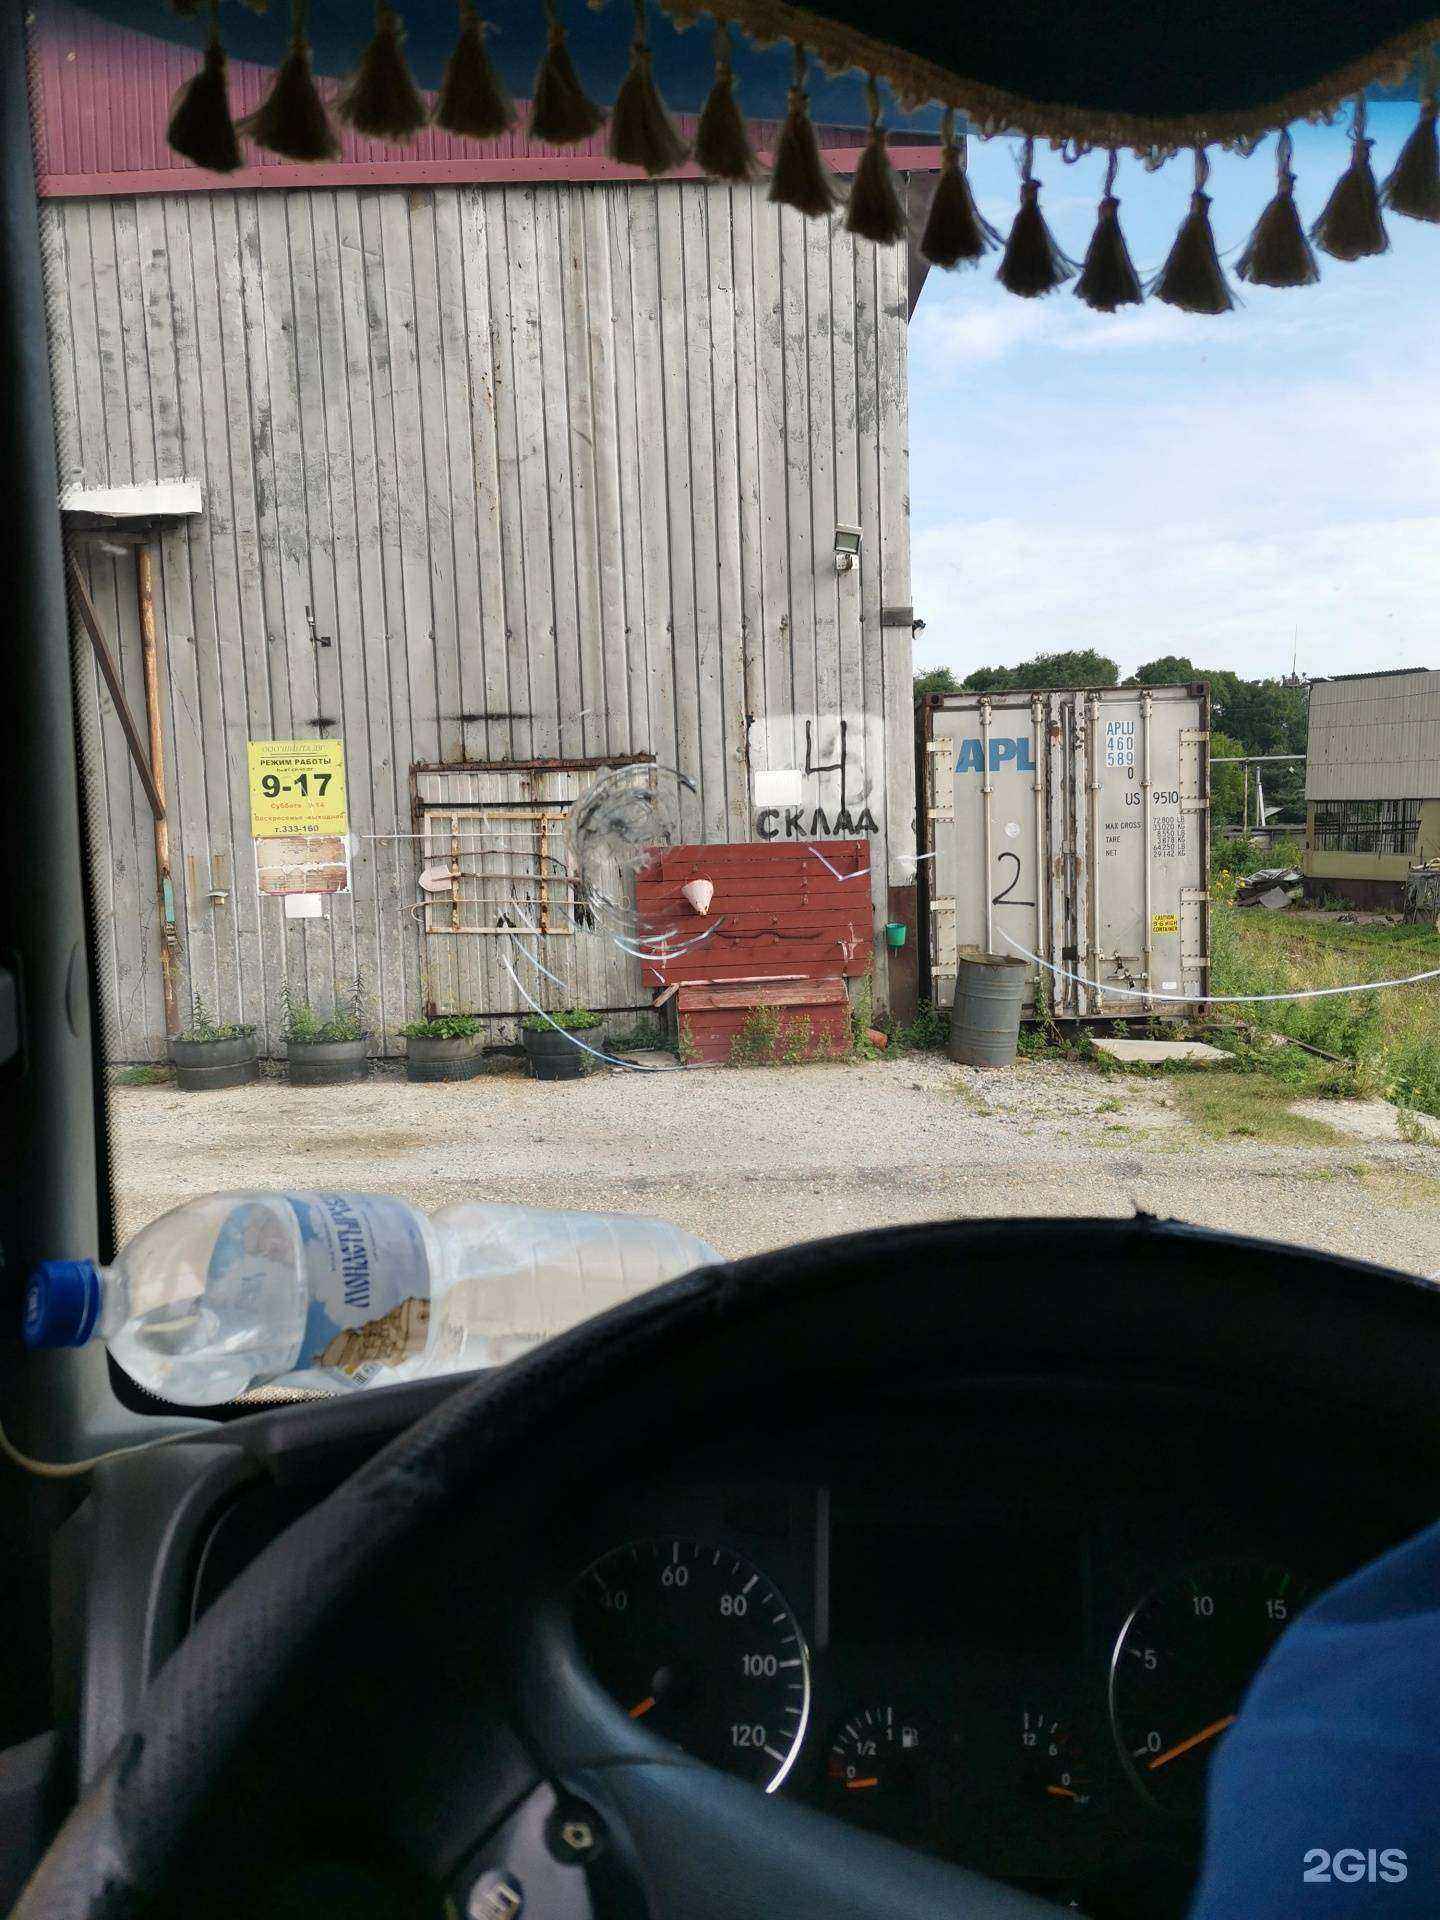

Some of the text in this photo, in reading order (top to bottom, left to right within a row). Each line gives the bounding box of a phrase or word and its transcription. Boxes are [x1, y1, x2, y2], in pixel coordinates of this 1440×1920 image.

[1106, 721, 1134, 736] APLU
[1107, 736, 1134, 751] 460
[260, 758, 331, 767] РЕЖИМ РАБОТЫ
[955, 737, 1036, 773] APL
[1107, 752, 1134, 767] 589
[805, 720, 848, 813] 4
[1127, 766, 1134, 780] 0
[261, 773, 333, 798] 9-17
[1125, 790, 1179, 806] US 9510
[1105, 822, 1119, 830] MAX
[992, 852, 1036, 907] 2
[661, 1565, 689, 1587] 60
[719, 1595, 748, 1617] 80
[1192, 1596, 1214, 1616] 10
[1265, 1599, 1287, 1620] 15
[742, 1653, 778, 1677] 100
[1144, 1649, 1157, 1670] 5
[730, 1725, 766, 1747] 120
[1147, 1731, 1162, 1752] 0
